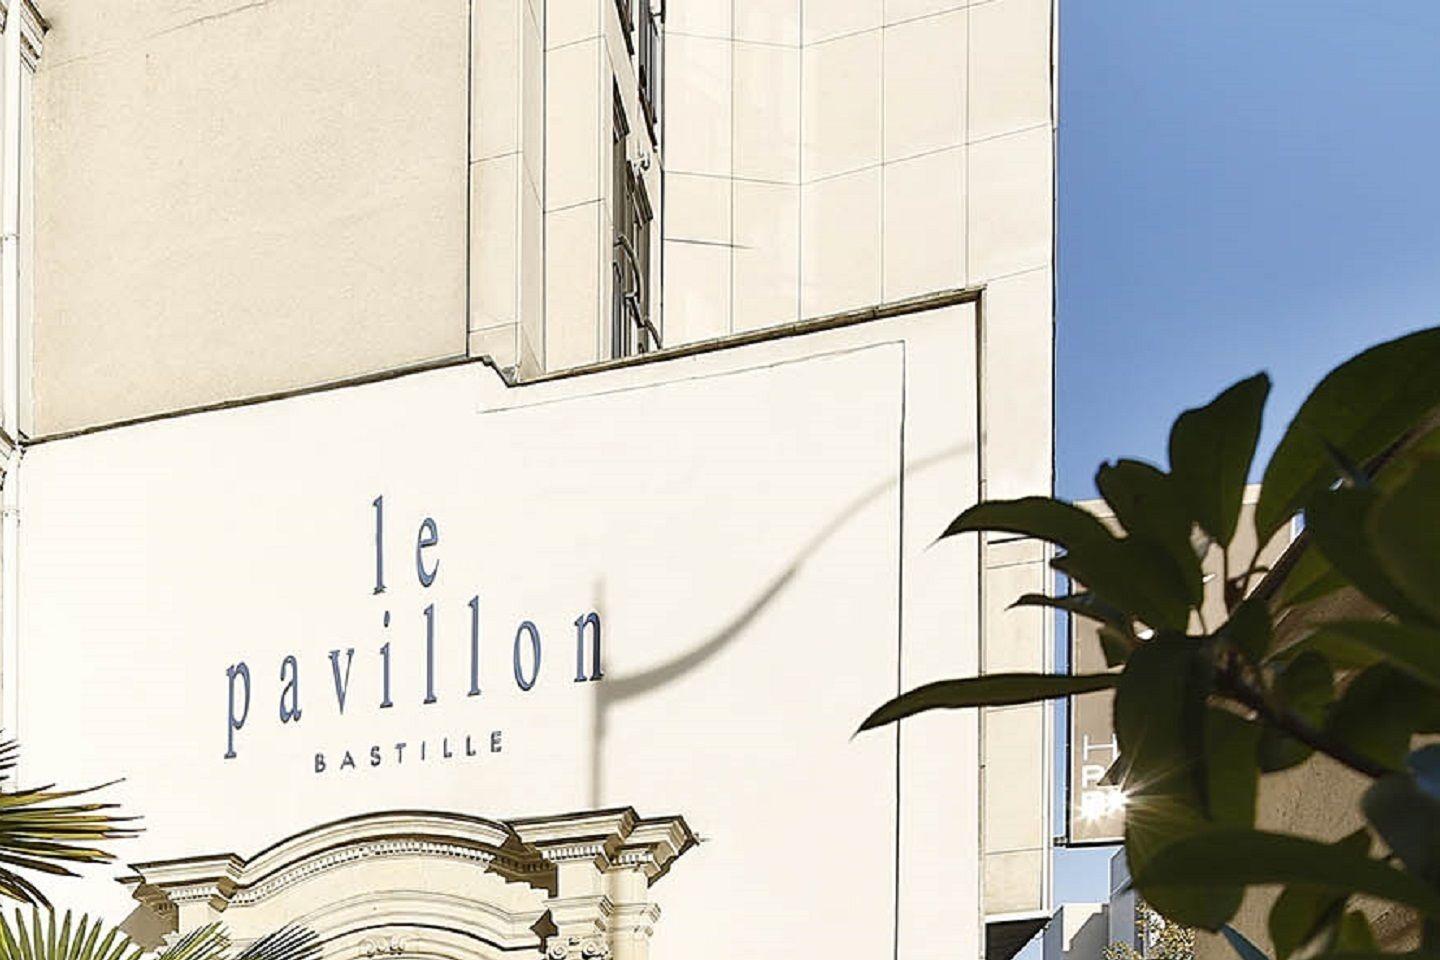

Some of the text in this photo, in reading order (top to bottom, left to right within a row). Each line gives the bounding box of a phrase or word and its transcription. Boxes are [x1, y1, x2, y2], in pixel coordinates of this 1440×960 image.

[372, 494, 440, 595] le
[223, 595, 605, 760] pavillon
[314, 731, 503, 773] BASTILLE
